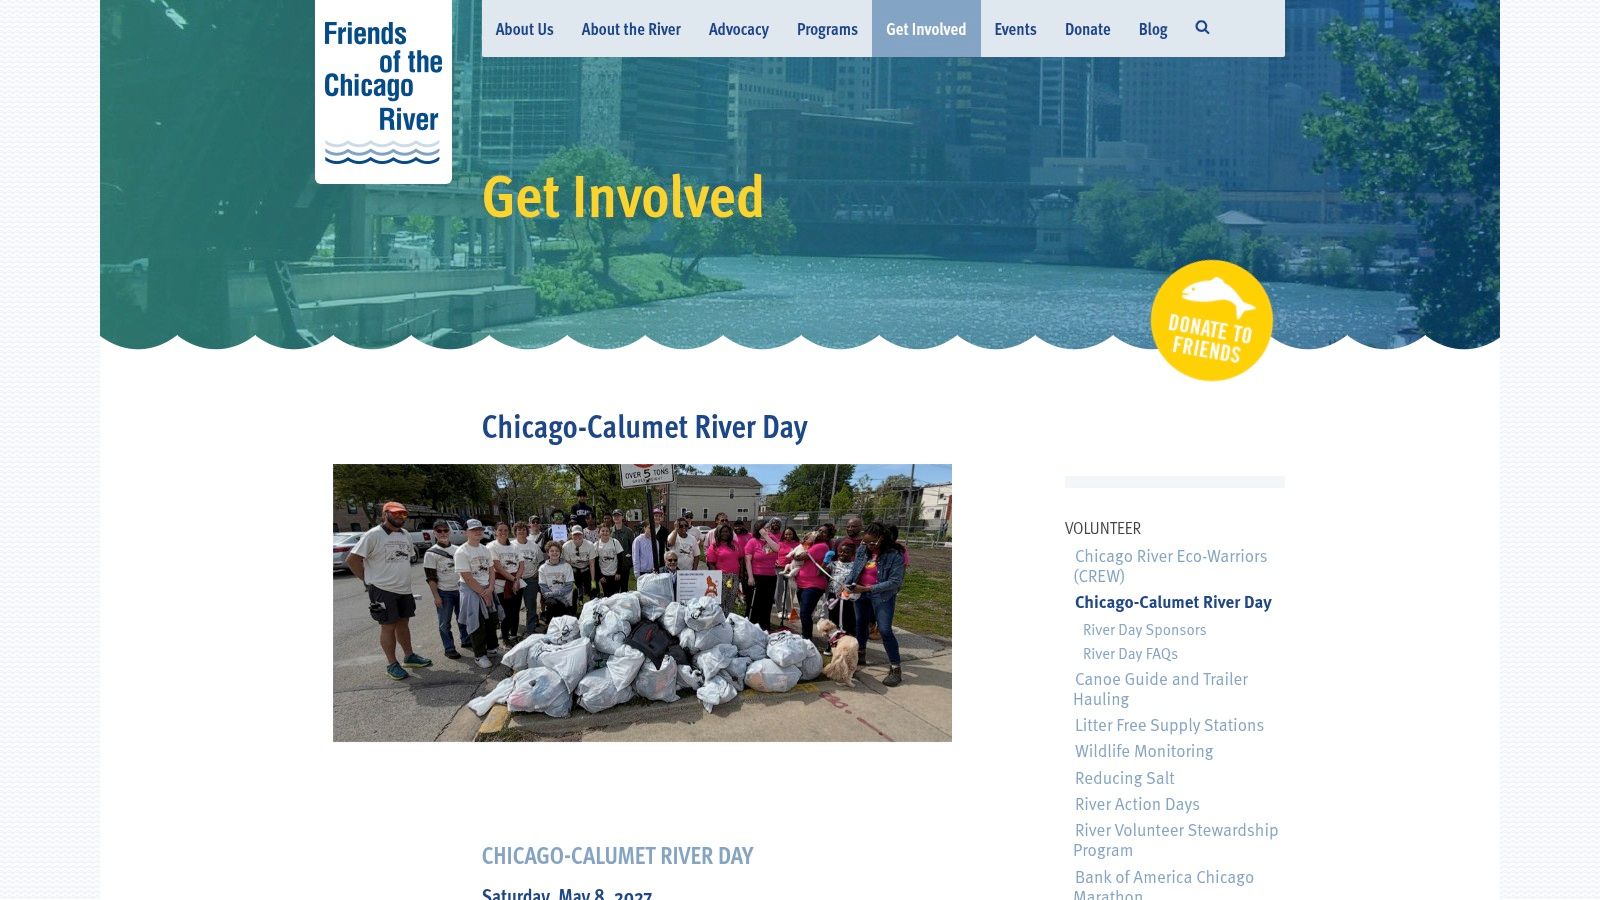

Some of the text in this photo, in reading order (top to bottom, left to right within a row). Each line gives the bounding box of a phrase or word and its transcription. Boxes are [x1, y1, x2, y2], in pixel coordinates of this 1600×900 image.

[324, 21, 407, 46] Friends
[495, 21, 554, 36] About Us
[581, 21, 682, 36] About the River
[708, 21, 770, 40] Advocacy
[797, 22, 859, 40] Programs
[886, 21, 967, 36] Get Involved
[994, 22, 1037, 36] Events
[1065, 22, 1111, 36] Donate
[1139, 21, 1168, 40] Blog
[379, 50, 443, 73] of the
[324, 73, 414, 102] Chicago
[379, 107, 439, 131] River
[483, 173, 763, 219] Get Involved
[1168, 313, 1252, 344] DONATE TO
[1172, 336, 1241, 364] FRIENDS
[482, 413, 809, 446] Chicago-Calumet River Day
[625, 471, 641, 480] OVER
[643, 469, 651, 479] 5
[653, 467, 670, 477] TONS
[1064, 521, 1142, 535] VOLUNTEER
[1075, 548, 1268, 566] Chicago River Eco-Warriors
[1073, 568, 1125, 586] (CREW)
[1075, 594, 1273, 613] Chicago-Calumet River Day
[1083, 623, 1207, 639] River Day Sponsors
[1083, 647, 1178, 663] River Day FAQs
[1075, 671, 1249, 686] Canoe Guide and Trailer
[1073, 691, 1130, 709] Hauling
[1075, 717, 1265, 736] Litter Free Supply Stations
[1074, 743, 1214, 761] Wildlife Monitoring
[1075, 770, 1175, 788] Reducing Salt
[1075, 796, 1200, 814] River Action Days
[1075, 822, 1279, 841] River Volunteer Stewardship
[482, 846, 755, 865] CHICAGO-CALUMET RIVER DAY
[1073, 843, 1133, 860] Program
[1075, 869, 1255, 887] Bank of America Chicago
[558, 888, 591, 900] May
[1073, 889, 1143, 900] Marathon
